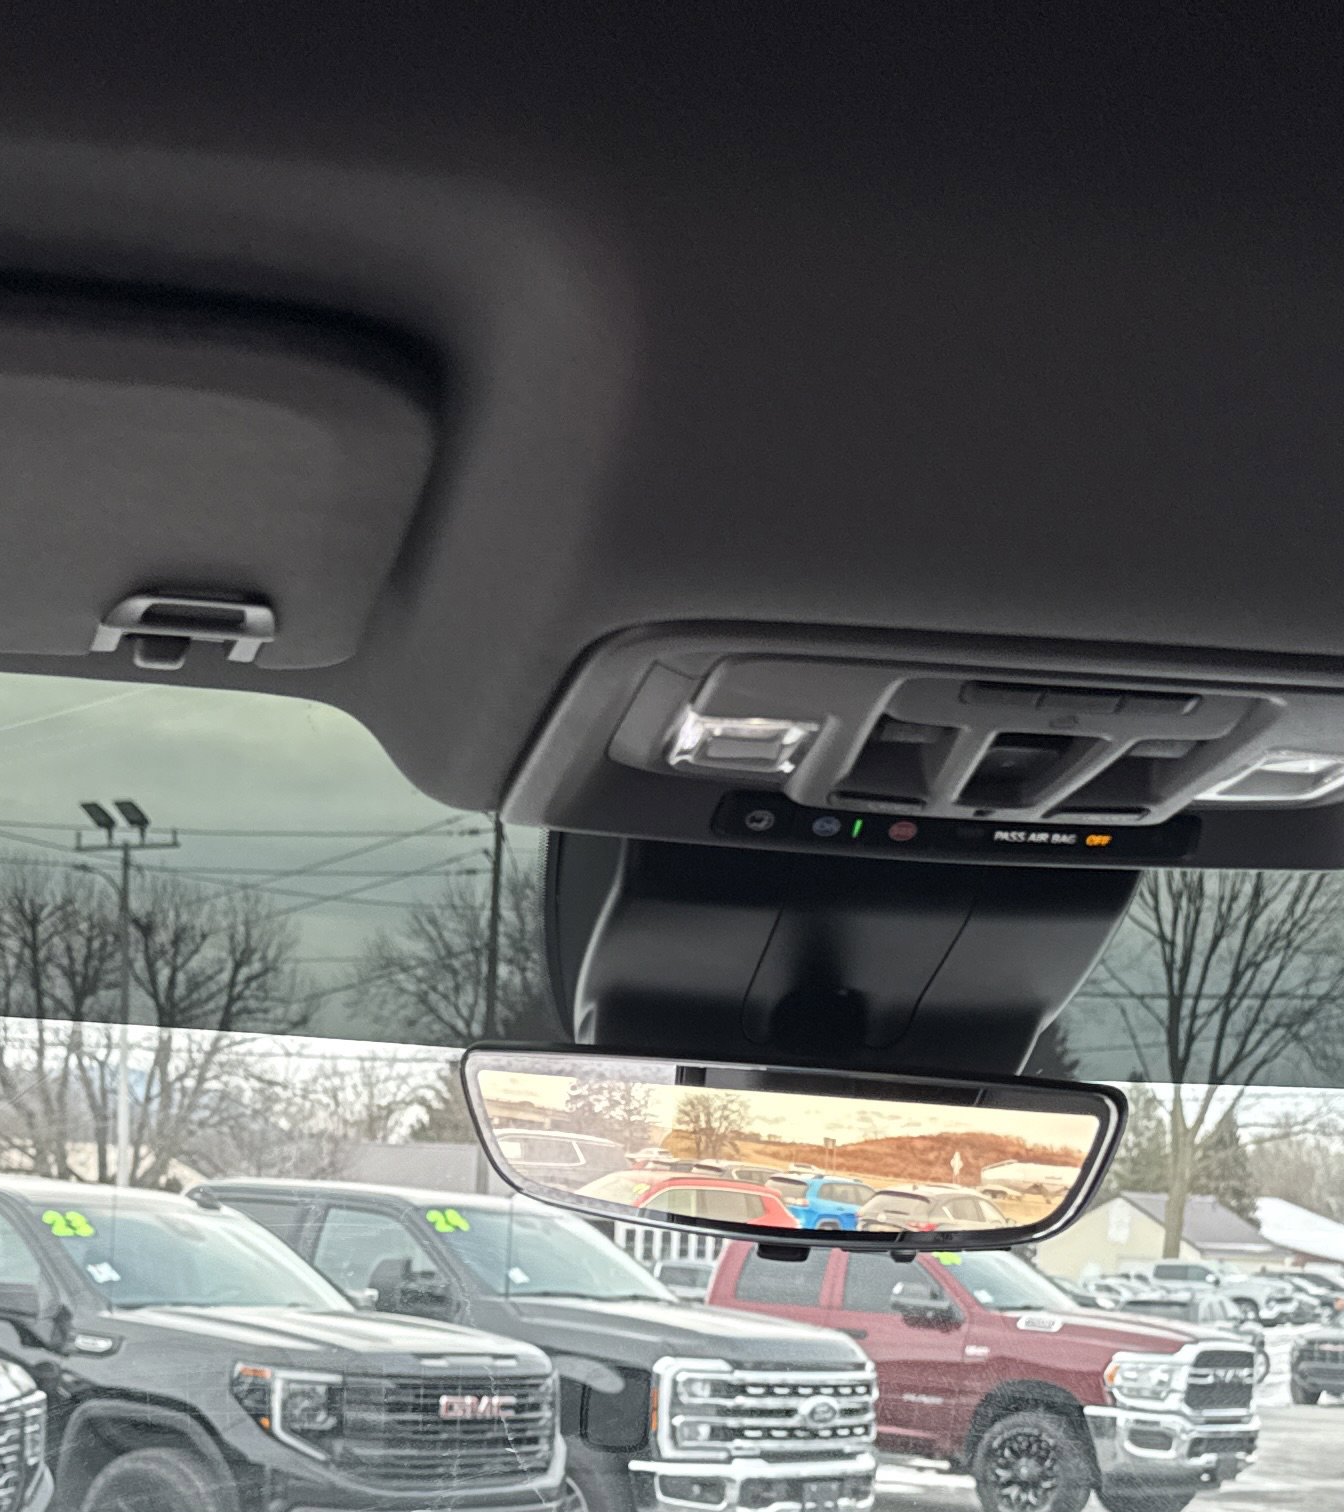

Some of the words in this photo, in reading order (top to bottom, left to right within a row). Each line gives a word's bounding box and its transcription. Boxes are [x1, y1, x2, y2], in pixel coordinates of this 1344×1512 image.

[993, 830, 1026, 843] PASS
[1027, 832, 1050, 844] AIR
[1051, 833, 1078, 845] BAG
[439, 1394, 517, 1419] GMC
